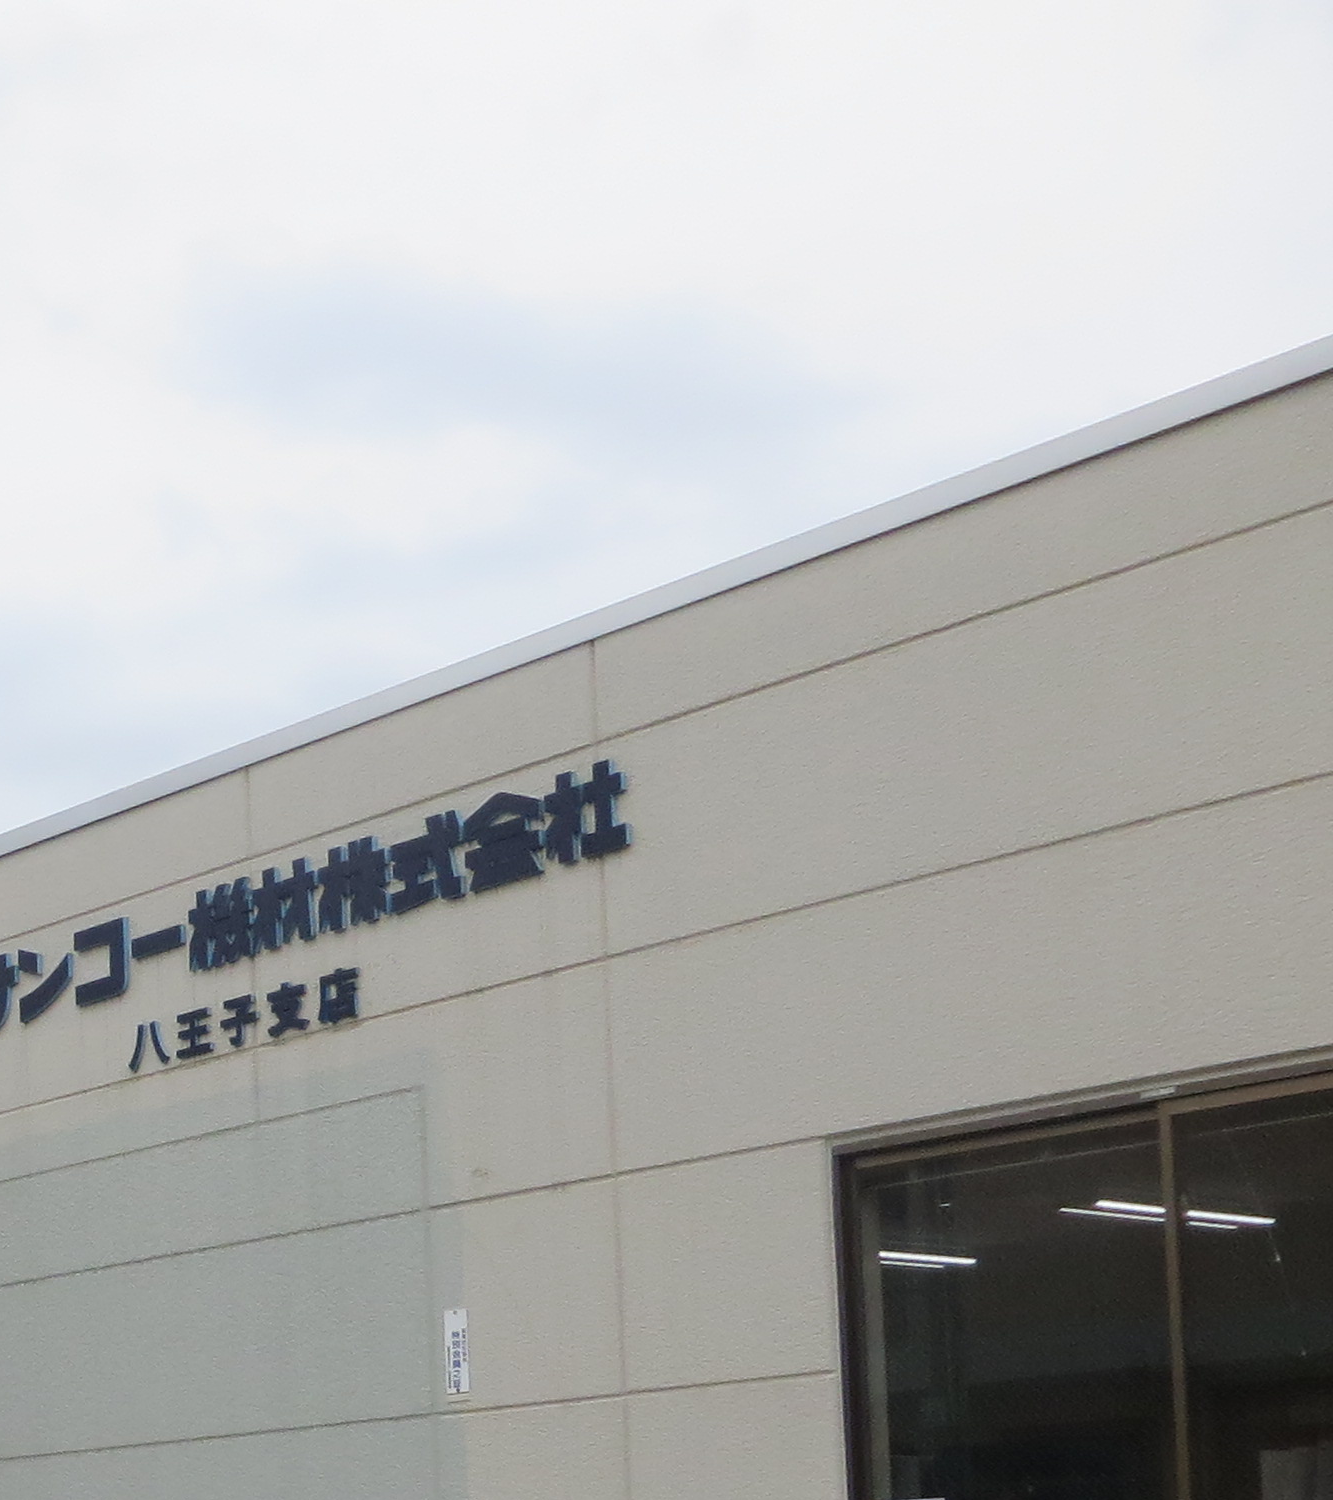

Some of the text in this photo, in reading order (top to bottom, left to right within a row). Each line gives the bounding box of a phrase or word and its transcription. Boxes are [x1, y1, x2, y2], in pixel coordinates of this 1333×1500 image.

[128, 967, 360, 1072] 八王子支店
